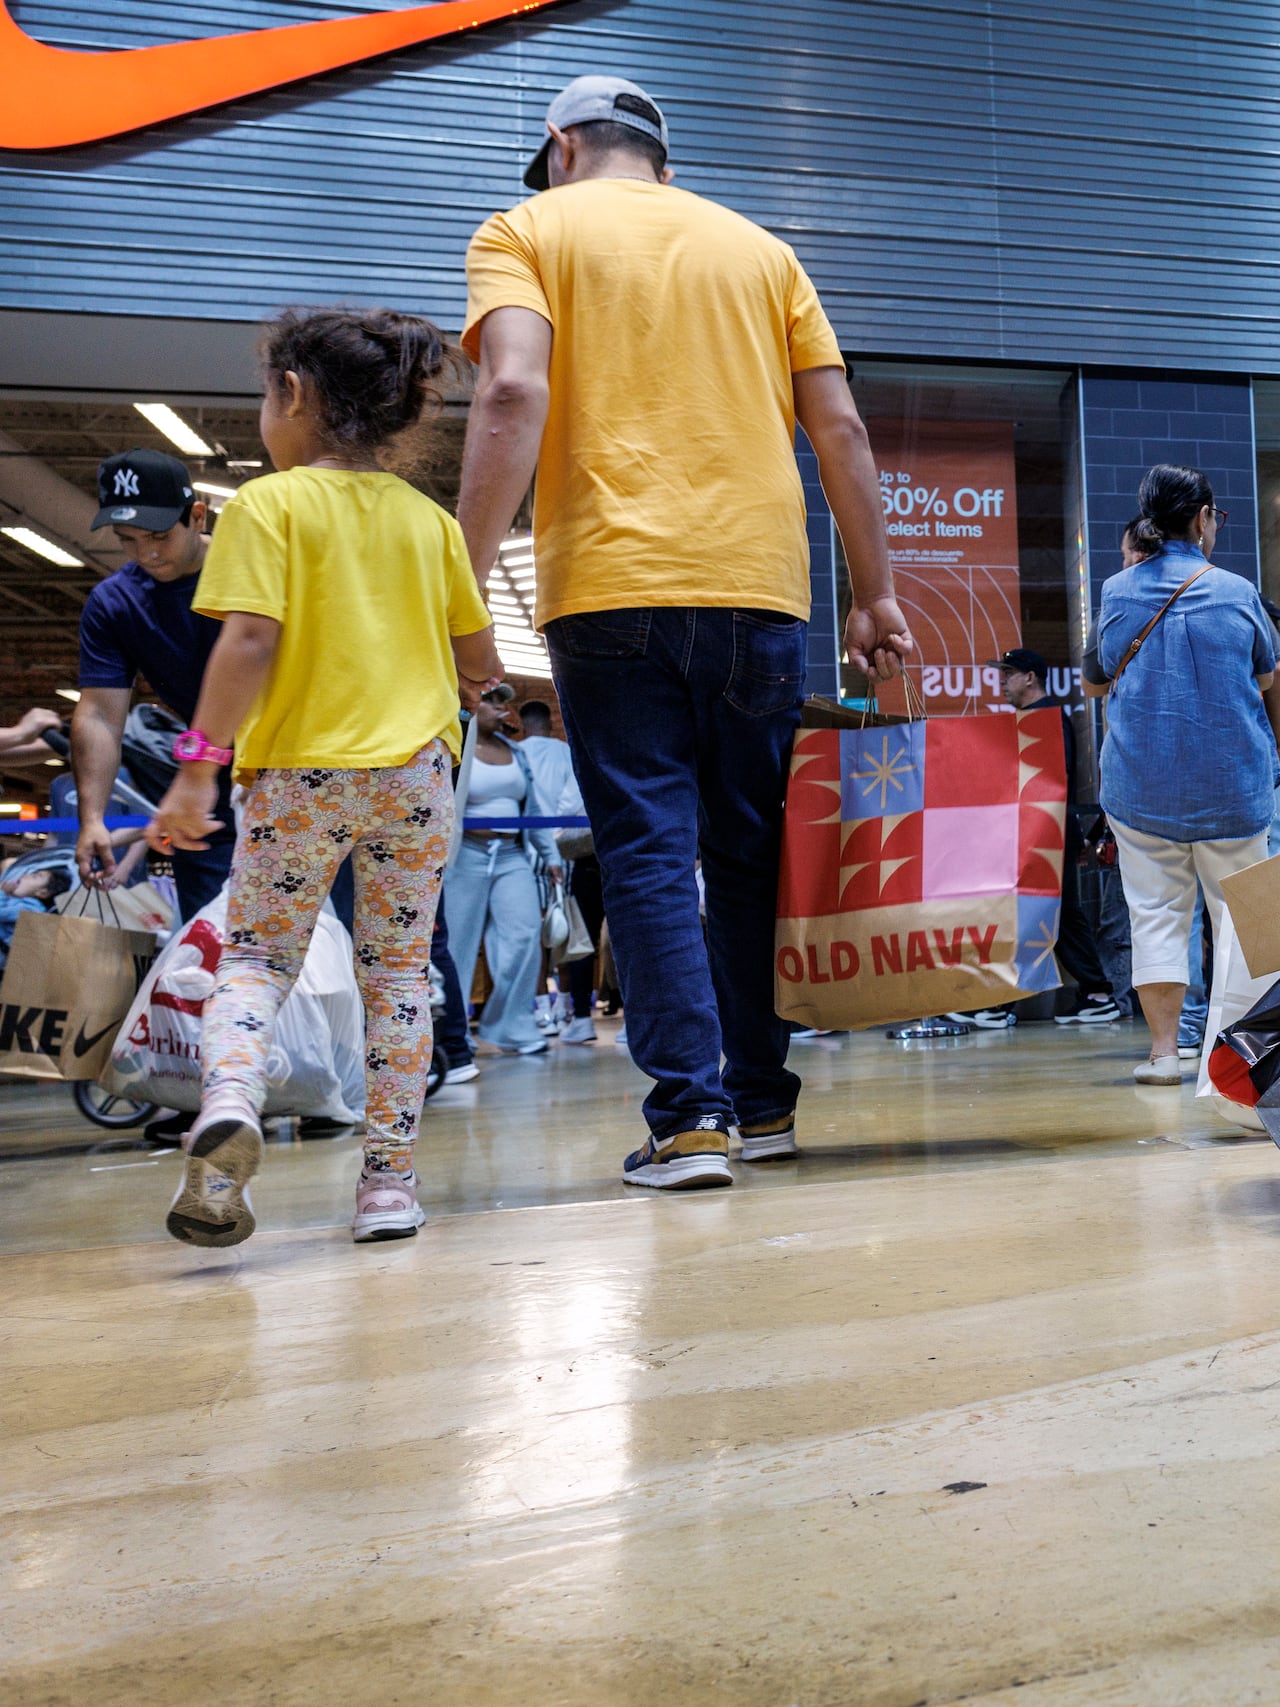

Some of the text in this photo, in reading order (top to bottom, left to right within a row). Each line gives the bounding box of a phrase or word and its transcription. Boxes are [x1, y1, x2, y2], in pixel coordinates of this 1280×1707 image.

[113, 468, 140, 497] NY
[897, 472, 911, 483] to
[953, 488, 1004, 517] Off
[886, 520, 983, 537] elect Items
[777, 924, 998, 984] OLD NAVY
[0, 1003, 68, 1056] KE
